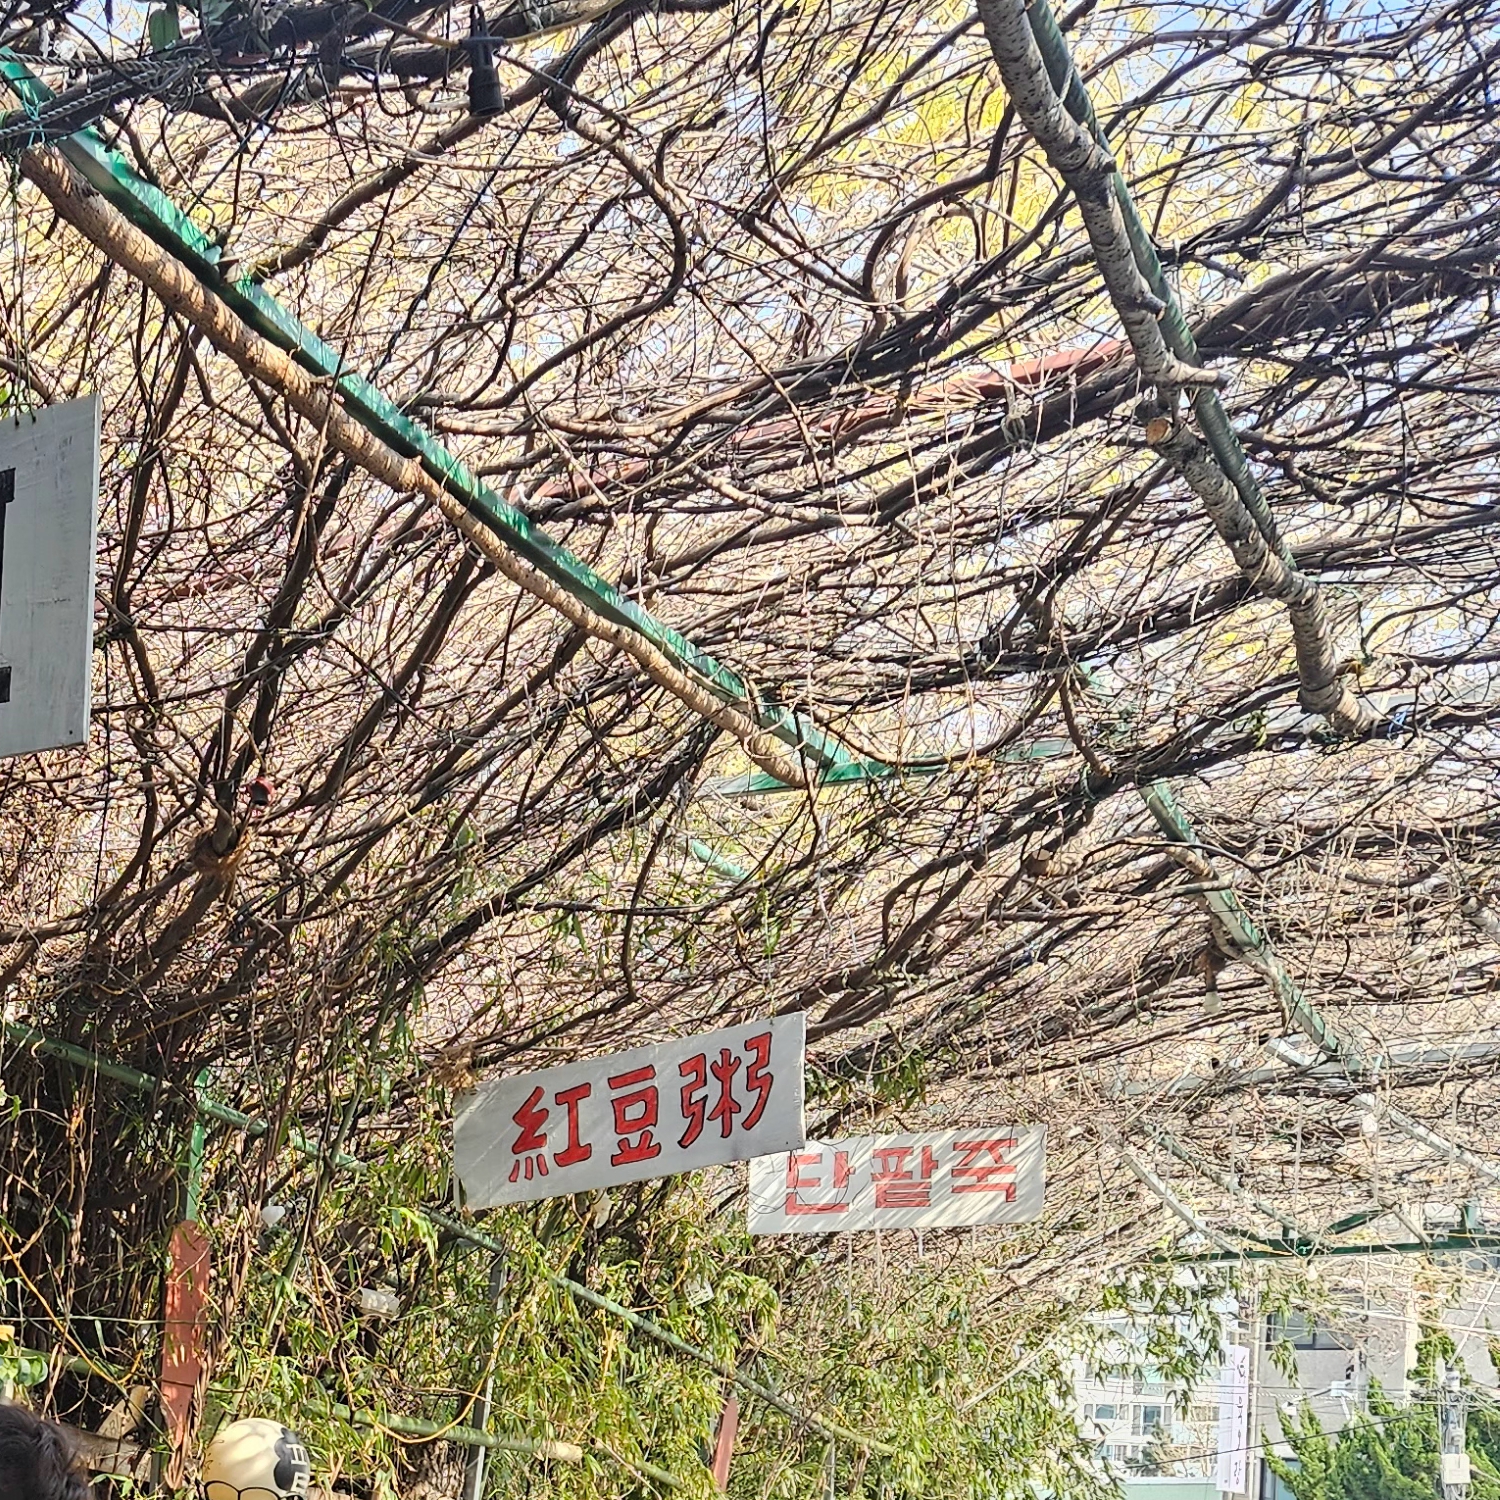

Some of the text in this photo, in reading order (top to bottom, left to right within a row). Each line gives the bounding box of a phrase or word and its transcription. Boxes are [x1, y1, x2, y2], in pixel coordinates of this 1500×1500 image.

[508, 1031, 774, 1183] 紅豆粥
[785, 1137, 1020, 1216] 단팥죽
